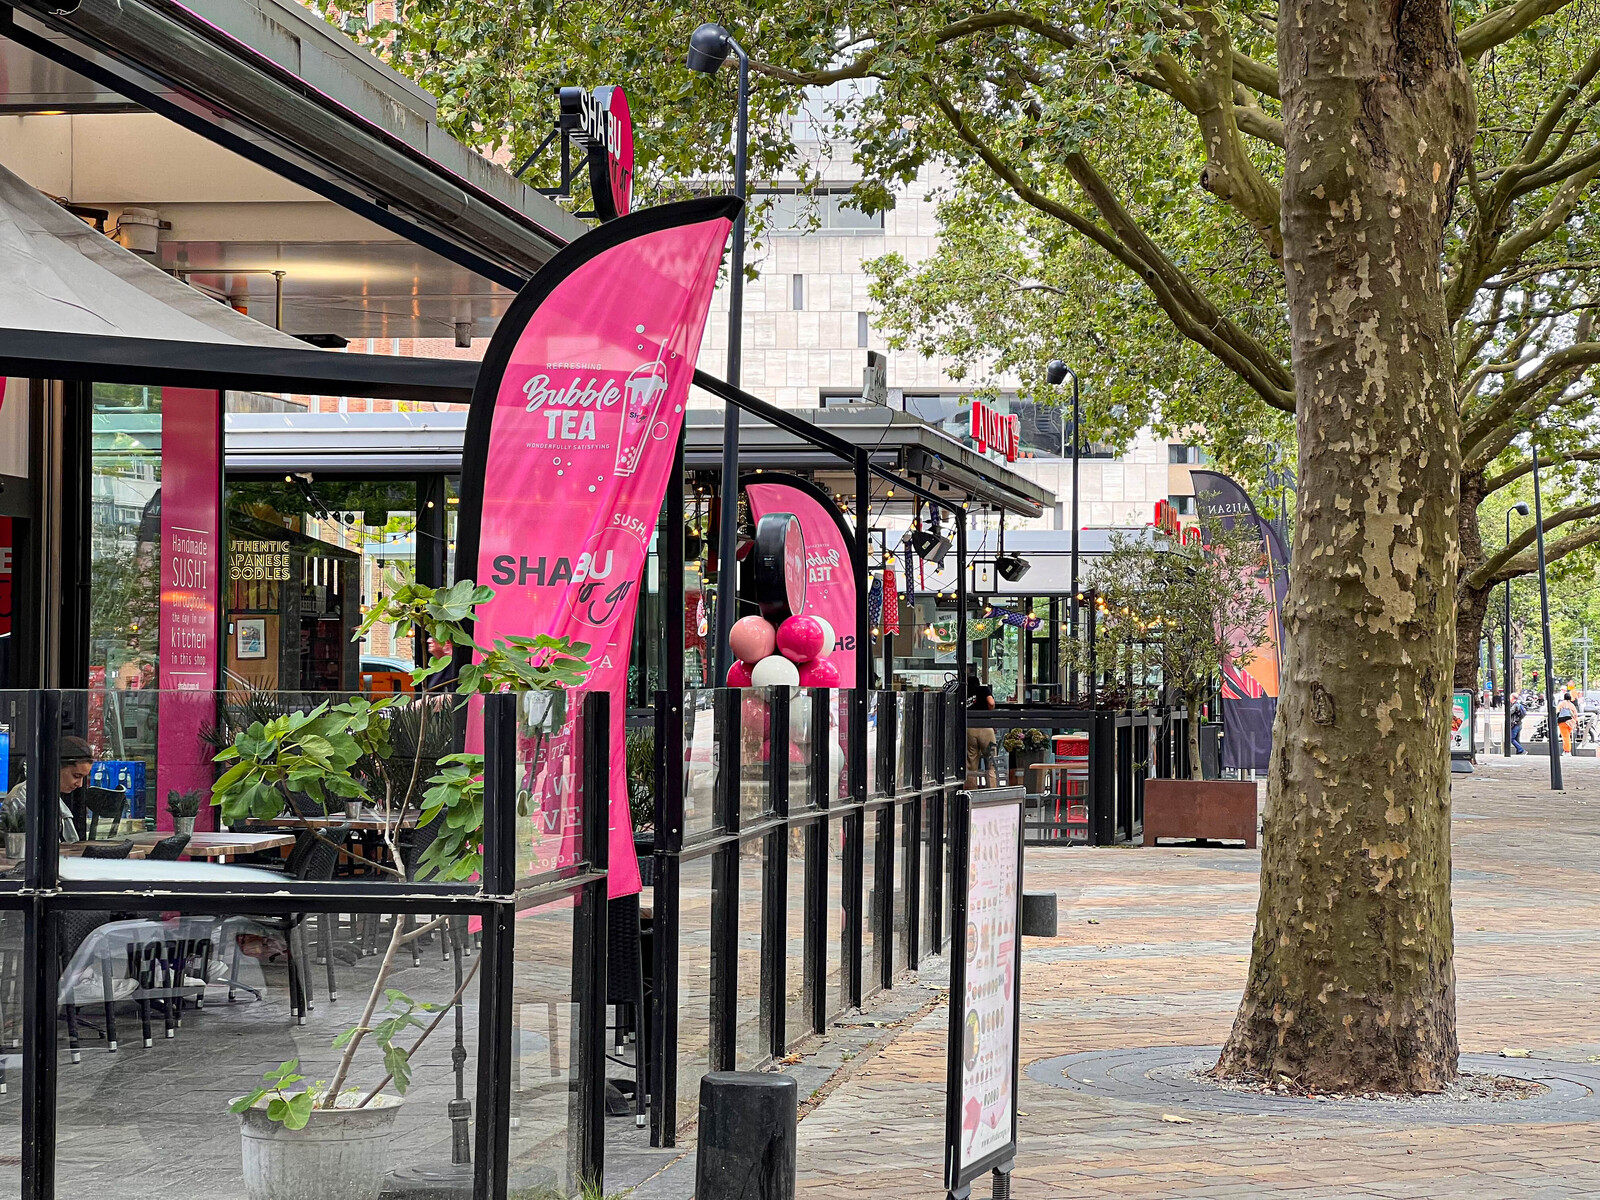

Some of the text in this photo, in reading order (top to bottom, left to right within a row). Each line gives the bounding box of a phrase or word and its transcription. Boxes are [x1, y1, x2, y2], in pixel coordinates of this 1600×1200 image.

[580, 87, 621, 160] SHABU
[546, 362, 602, 371] REFRESHING
[522, 374, 621, 413] Bubble
[543, 410, 596, 440] TEA
[526, 442, 572, 450] WONDERFULLY
[172, 534, 207, 556] Handmade
[229, 541, 290, 552] UTHENTIC
[172, 557, 207, 590] SUSHI
[231, 567, 291, 580] OODLES
[491, 549, 614, 586] SHABU
[172, 592, 206, 611] throughout
[171, 627, 207, 649] kitchen
[171, 652, 178, 664] in
[180, 653, 192, 665] this
